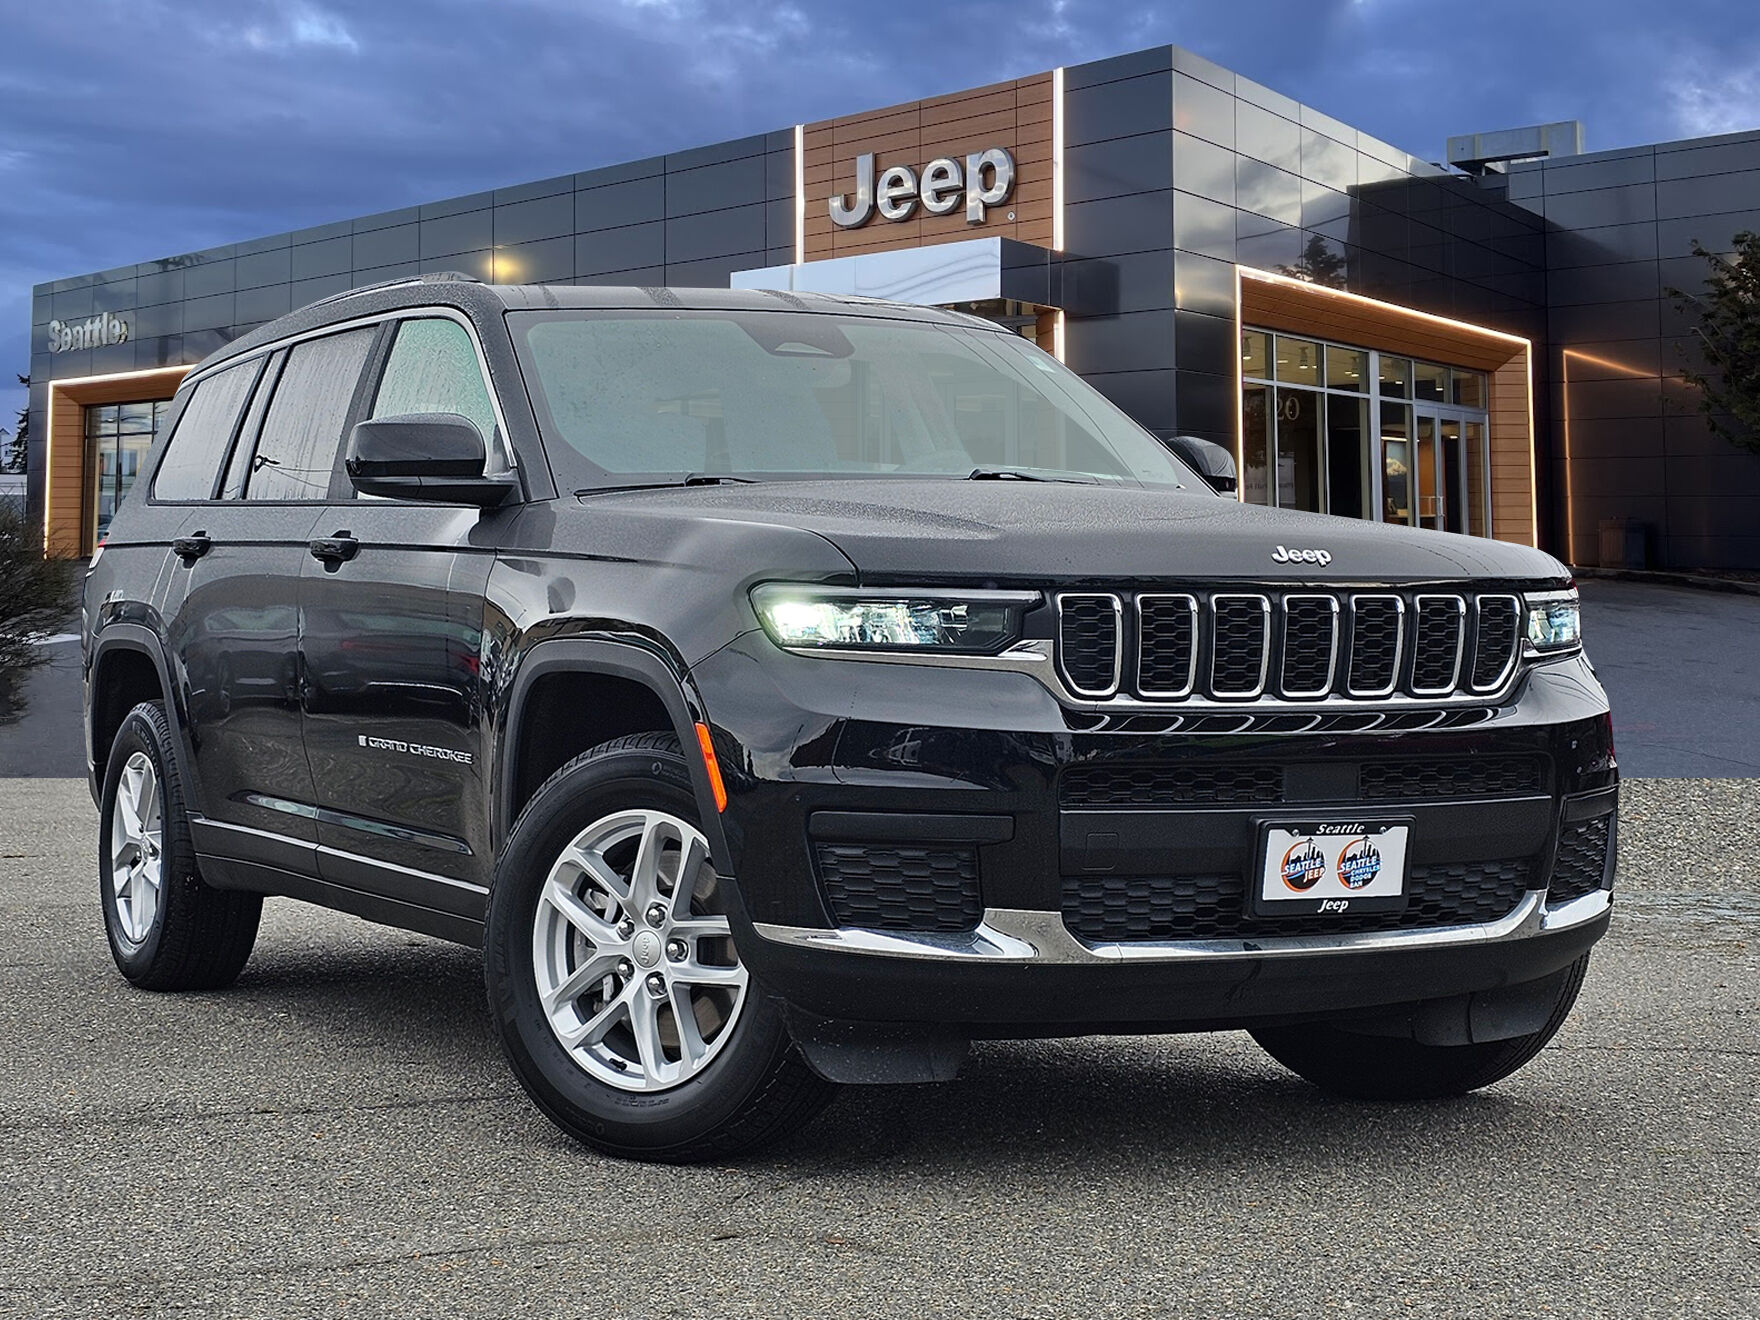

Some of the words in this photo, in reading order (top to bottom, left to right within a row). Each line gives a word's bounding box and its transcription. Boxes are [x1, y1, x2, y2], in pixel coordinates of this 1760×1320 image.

[828, 148, 1017, 229] Jeep
[48, 311, 128, 353] Seattle
[1271, 545, 1333, 567] Jeep
[368, 737, 408, 752] GRAND
[409, 743, 473, 765] CHEROKEE
[1317, 823, 1366, 834] Seattle
[1284, 859, 1321, 873] SEATTLE
[1340, 857, 1377, 872] SEATTLE
[1303, 867, 1325, 882] JEEP
[1350, 872, 1372, 881] DODGE
[1318, 900, 1349, 912] Jeep
